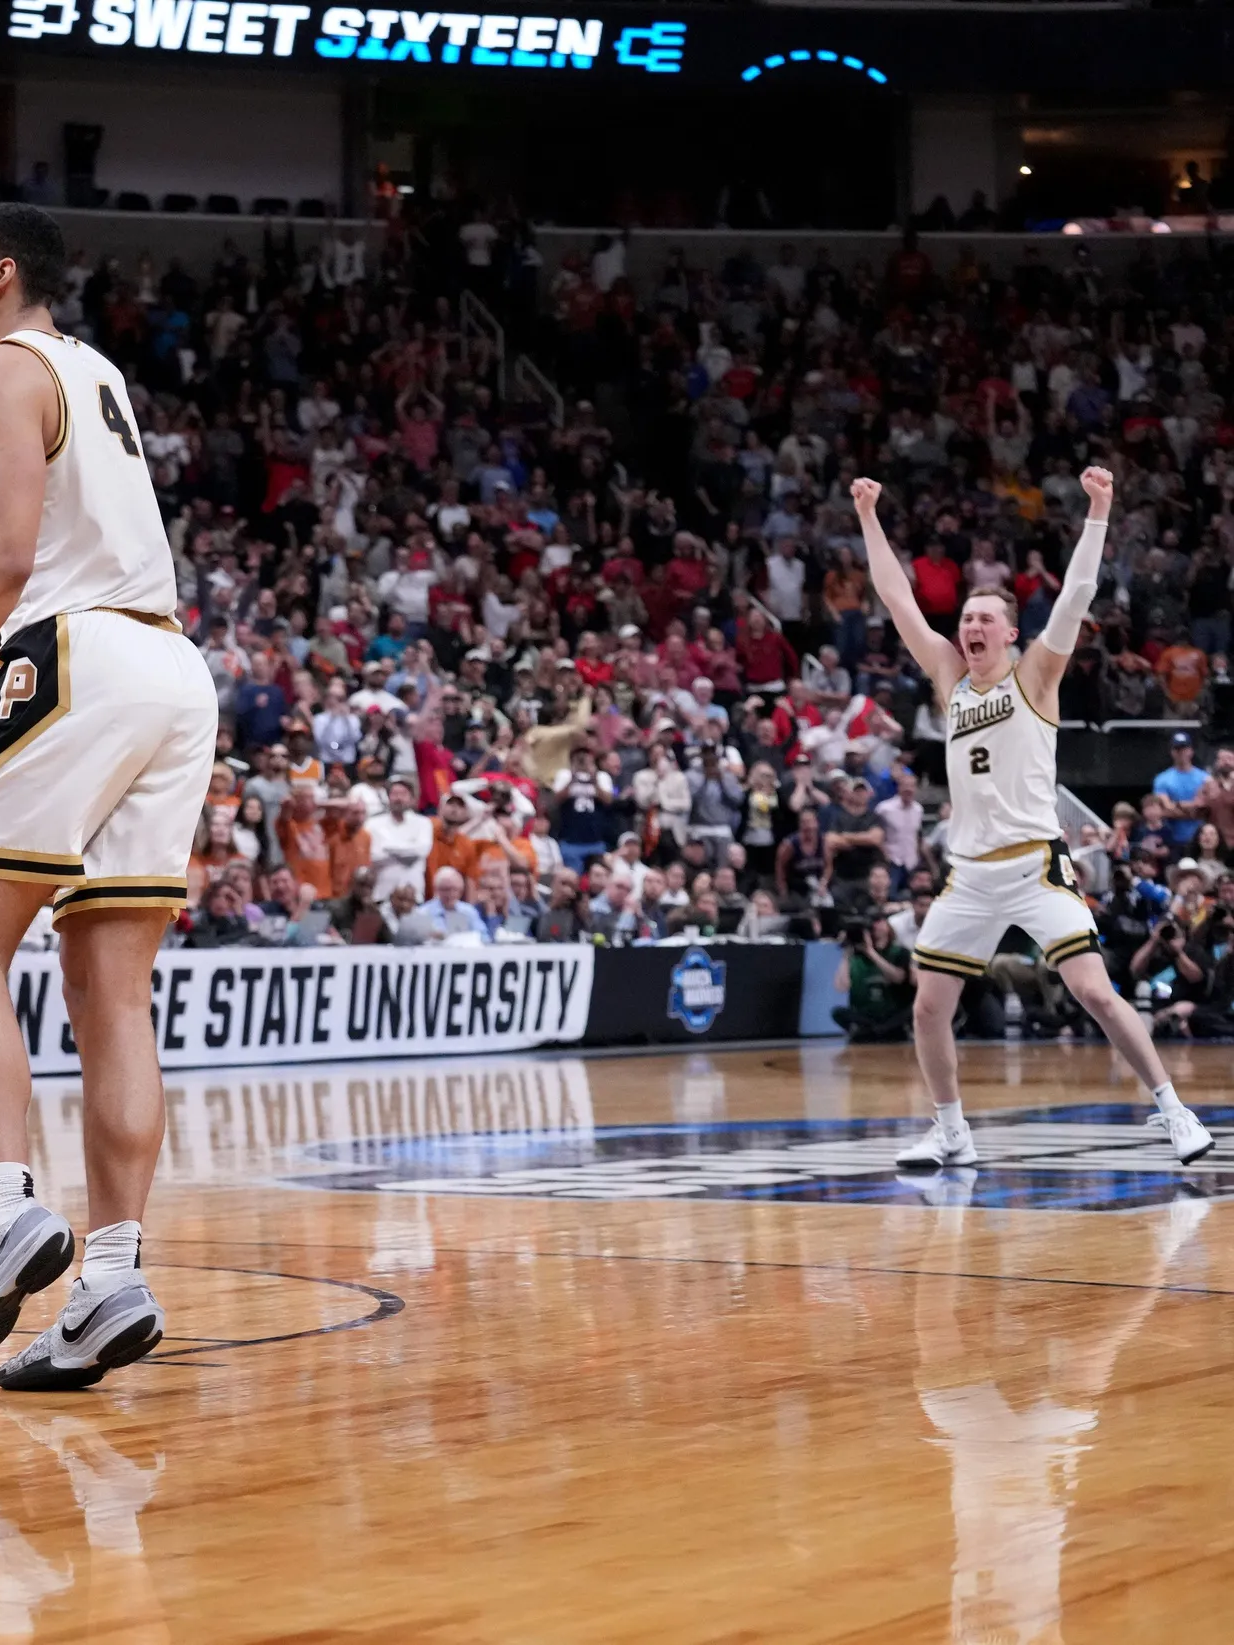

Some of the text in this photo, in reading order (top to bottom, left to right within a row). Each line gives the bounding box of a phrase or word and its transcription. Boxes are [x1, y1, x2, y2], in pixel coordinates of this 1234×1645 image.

[89, 0, 603, 68] SWEET SIXTEEN
[95, 381, 142, 459] 4
[950, 694, 1014, 734] Purdue
[969, 746, 991, 775] 2
[204, 965, 336, 1048] STATE
[346, 960, 579, 1041] UNIVERSITY
